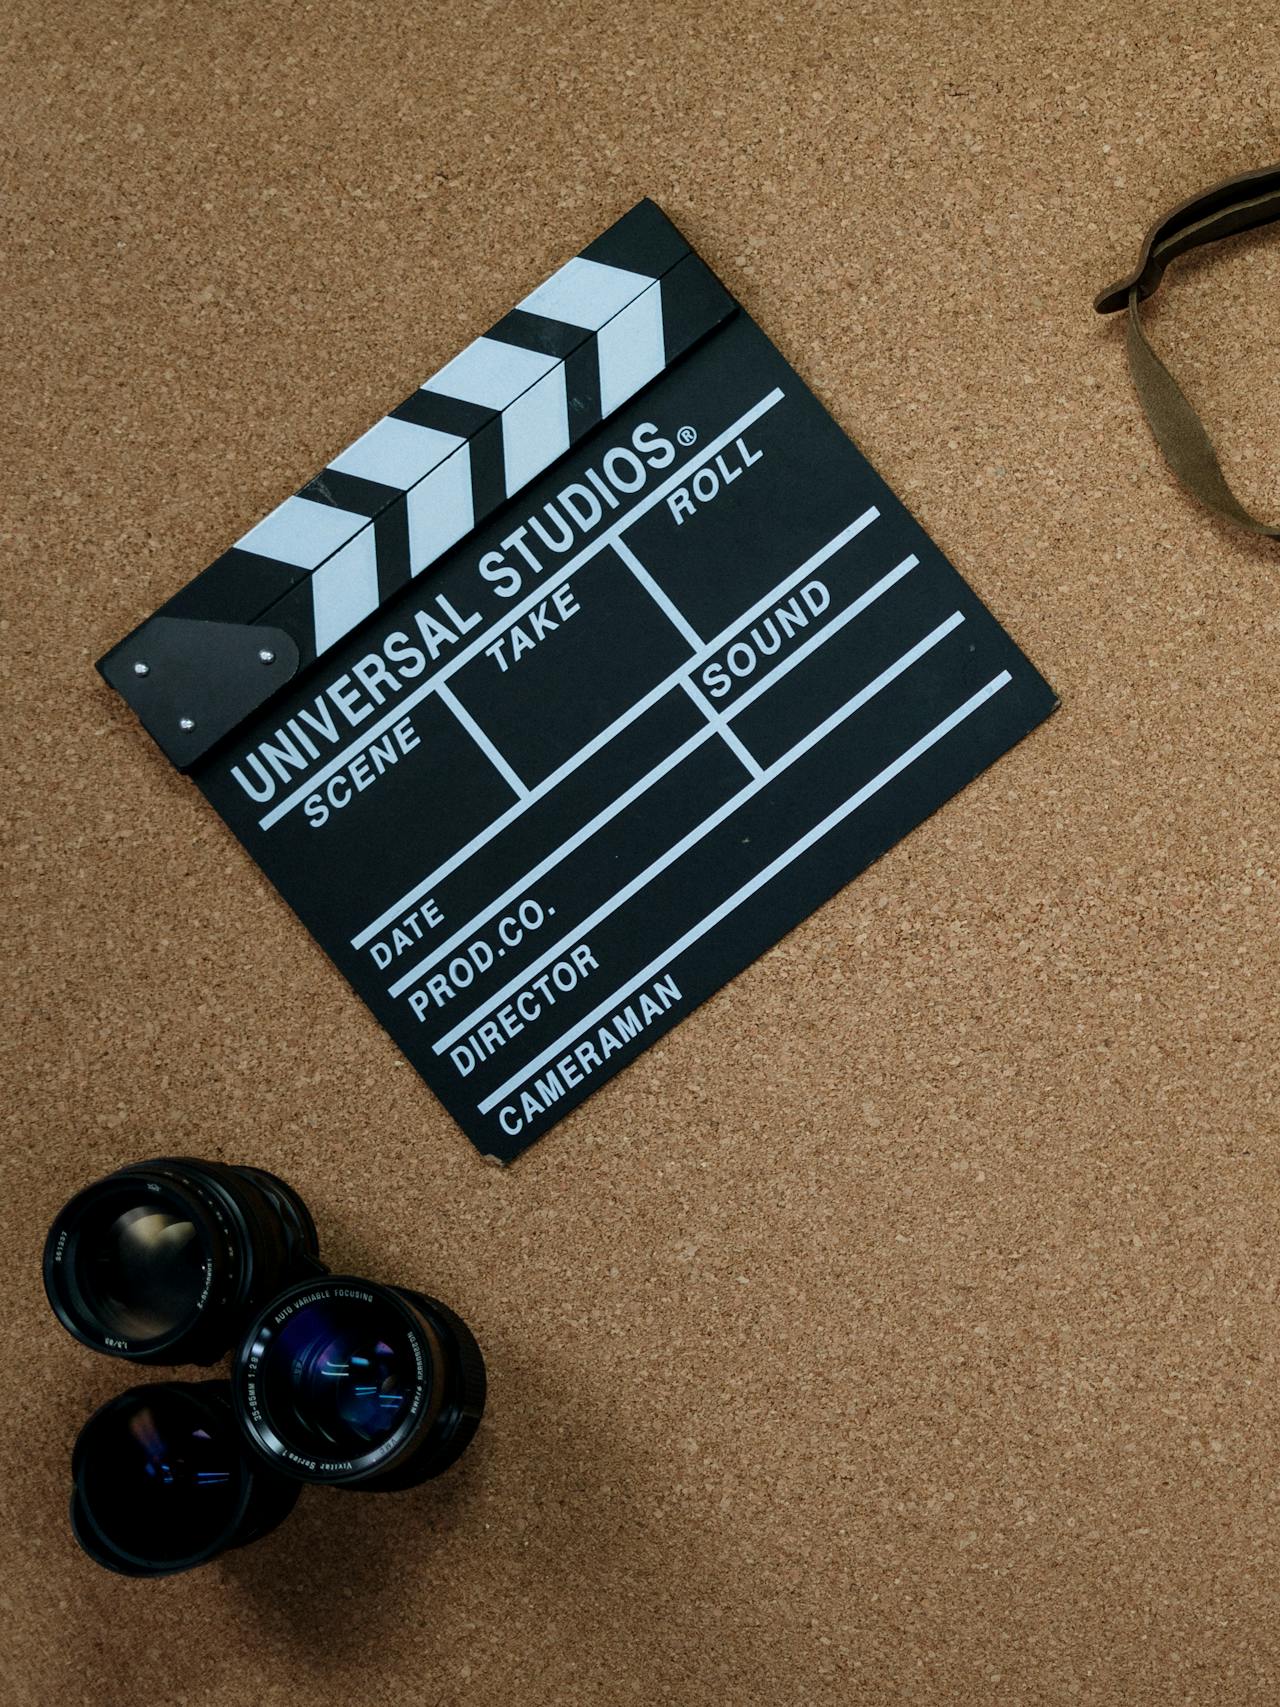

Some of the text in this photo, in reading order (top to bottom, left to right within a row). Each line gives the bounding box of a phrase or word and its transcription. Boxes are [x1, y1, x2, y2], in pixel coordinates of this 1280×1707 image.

[666, 437, 764, 526] ROLL
[484, 582, 581, 673] TAKE
[702, 580, 831, 698] SOUND
[230, 593, 484, 803] UNIVERSAL
[303, 716, 421, 828] SCENE
[369, 898, 445, 970] DATE
[407, 899, 556, 1023] PROD.CO.
[449, 944, 600, 1078] DIRECTOR
[498, 973, 683, 1136] CAMERAMAN
[275, 1289, 374, 1324] AUTO VARIABLE FOCUSING
[289, 1453, 316, 1470] Series
[320, 1461, 353, 1471] Vivitar
